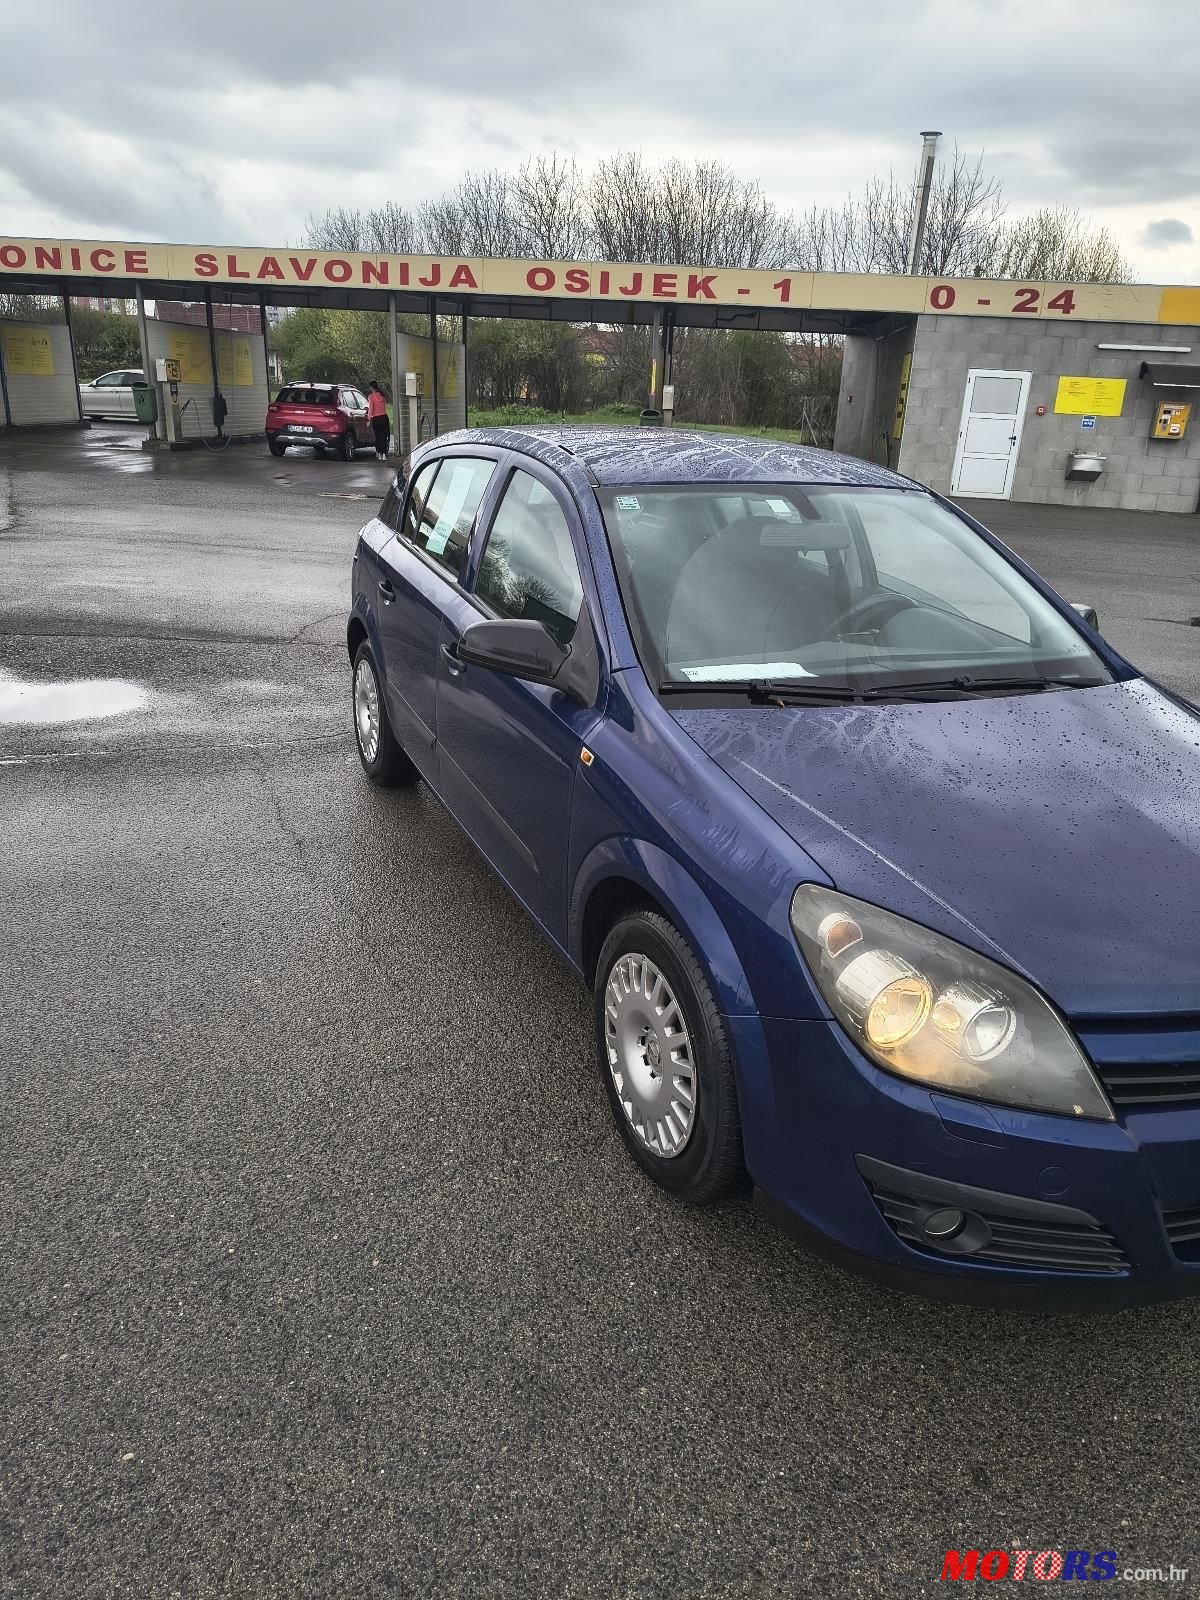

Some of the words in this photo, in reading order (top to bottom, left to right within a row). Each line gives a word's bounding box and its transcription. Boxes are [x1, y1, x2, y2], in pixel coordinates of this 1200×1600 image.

[0, 245, 149, 274] ONICE
[194, 252, 479, 289] SLAVONIJA
[526, 266, 719, 299] OSIJEK
[773, 278, 792, 303] 1
[930, 285, 956, 310] 0
[1011, 289, 1076, 315] 24
